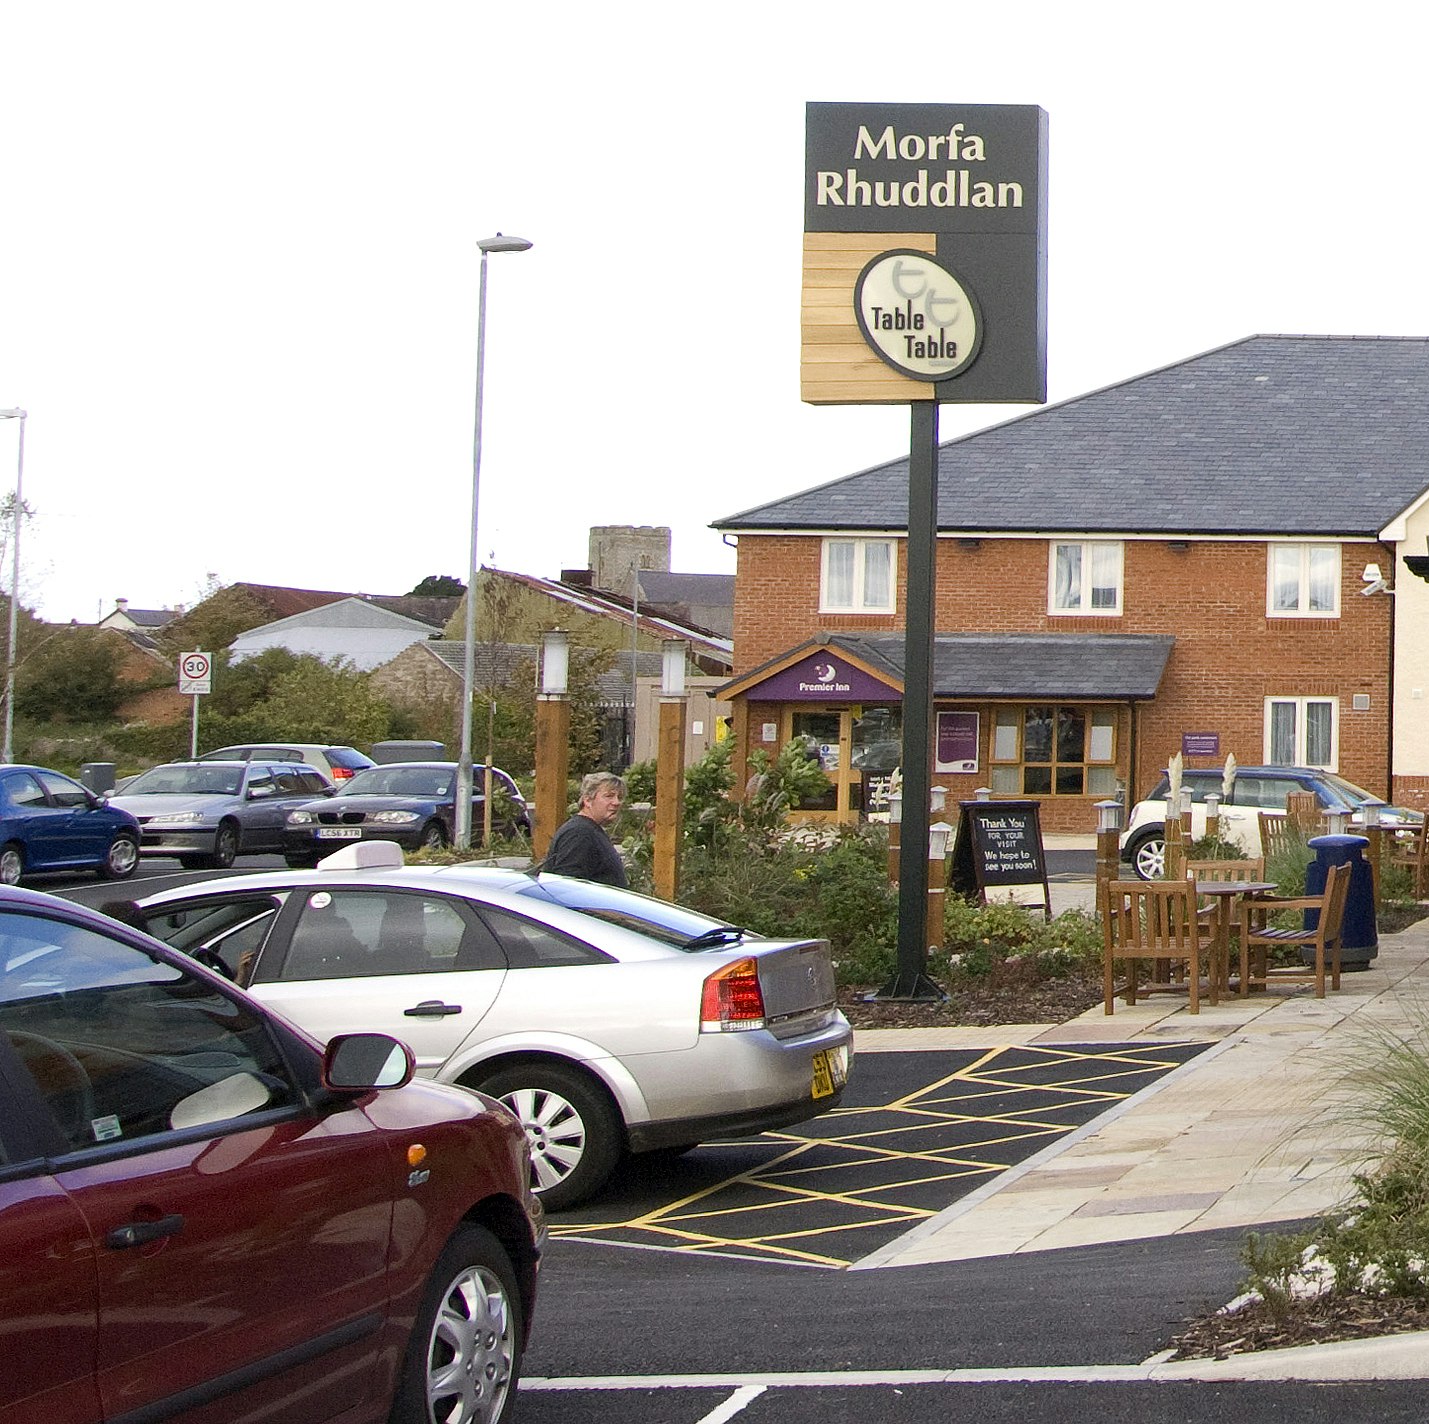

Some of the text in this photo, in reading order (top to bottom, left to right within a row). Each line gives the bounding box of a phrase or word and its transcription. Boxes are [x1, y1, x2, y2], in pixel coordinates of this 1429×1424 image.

[854, 123, 986, 161] Morfa
[816, 169, 1023, 208] Rhuddlan
[871, 299, 924, 330] Table
[904, 328, 957, 359] Table
[186, 661, 206, 672] 30
[799, 682, 850, 692] Premier Inn
[980, 818, 1007, 828] Thank
[987, 832, 1002, 840] FOR
[996, 840, 1017, 848] VISIT
[984, 850, 1030, 861] We hope to
